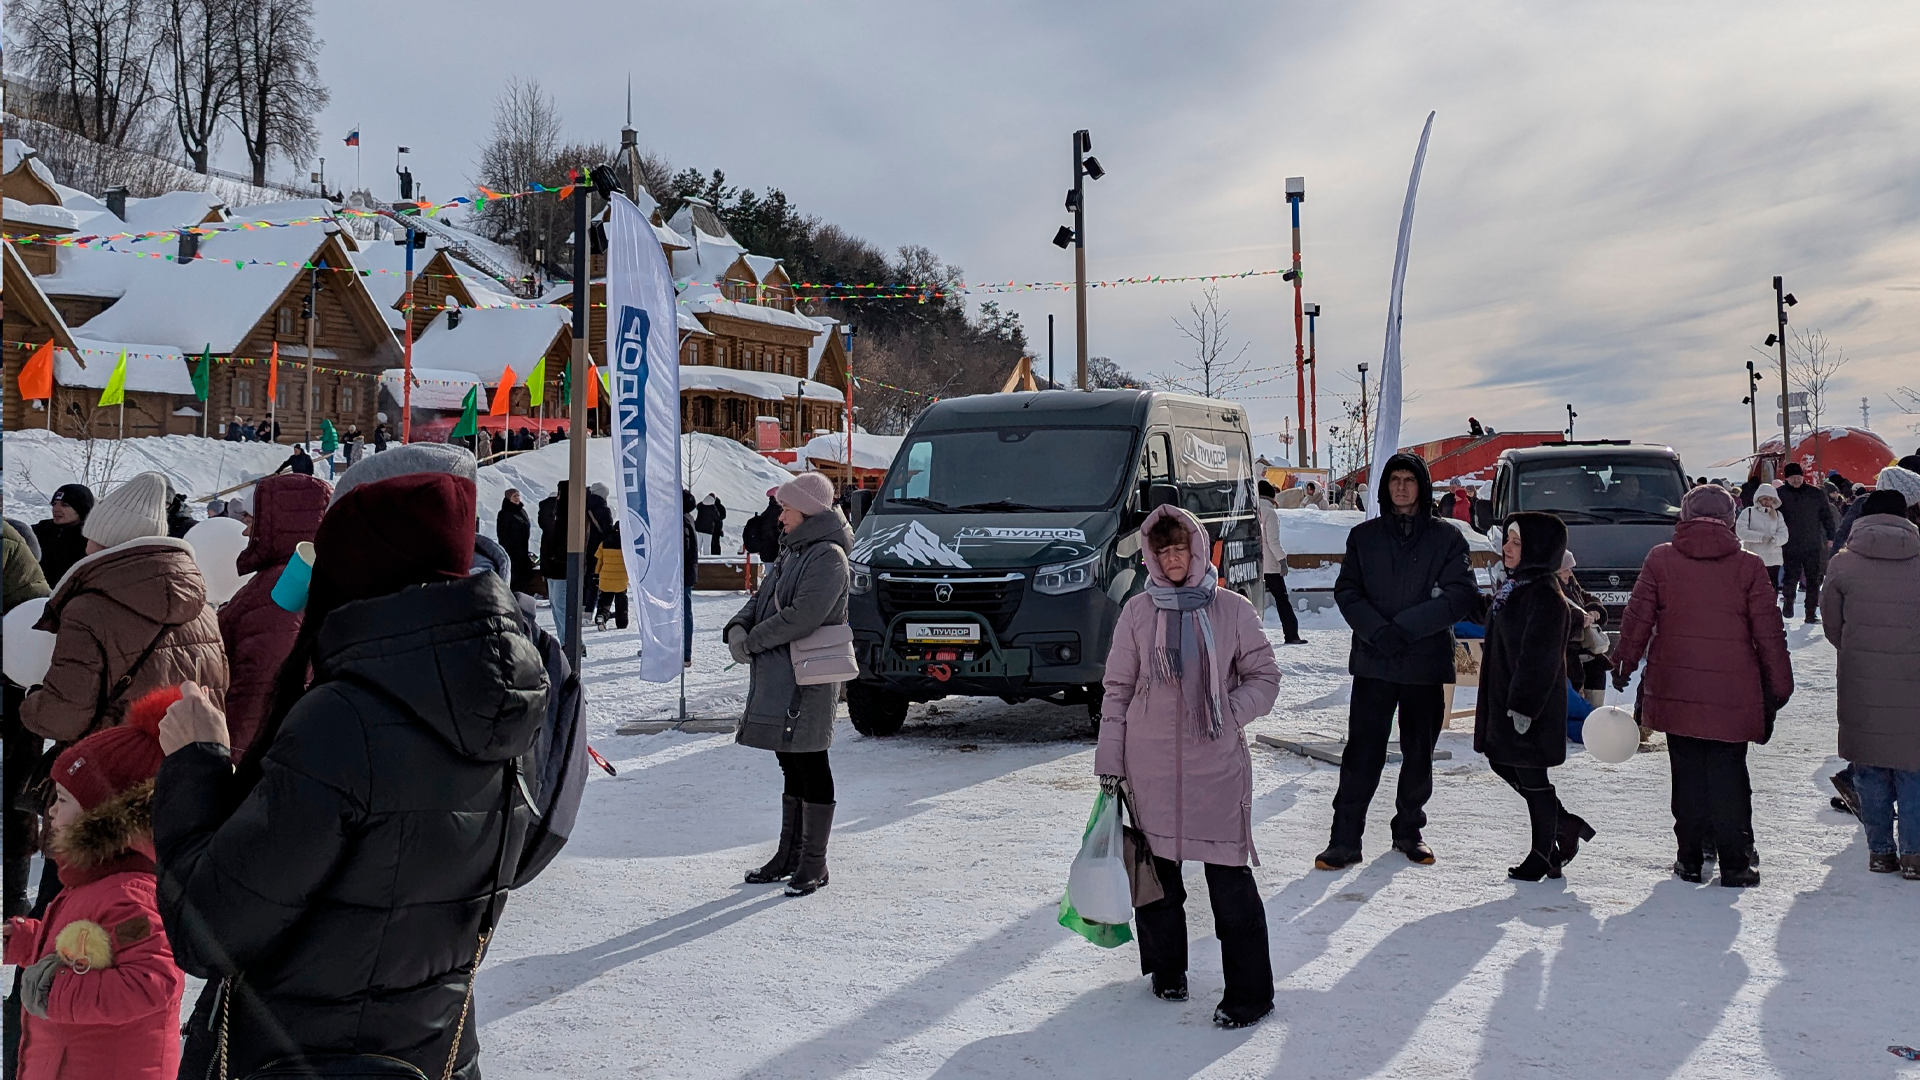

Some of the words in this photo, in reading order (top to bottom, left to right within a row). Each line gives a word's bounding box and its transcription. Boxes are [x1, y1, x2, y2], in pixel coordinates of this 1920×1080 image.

[1197, 444, 1226, 468] ЛУИДОР
[995, 529, 1082, 539] ЛУИДОР
[1595, 592, 1627, 602] 225УУ
[932, 628, 969, 637] ЛУИДОР
